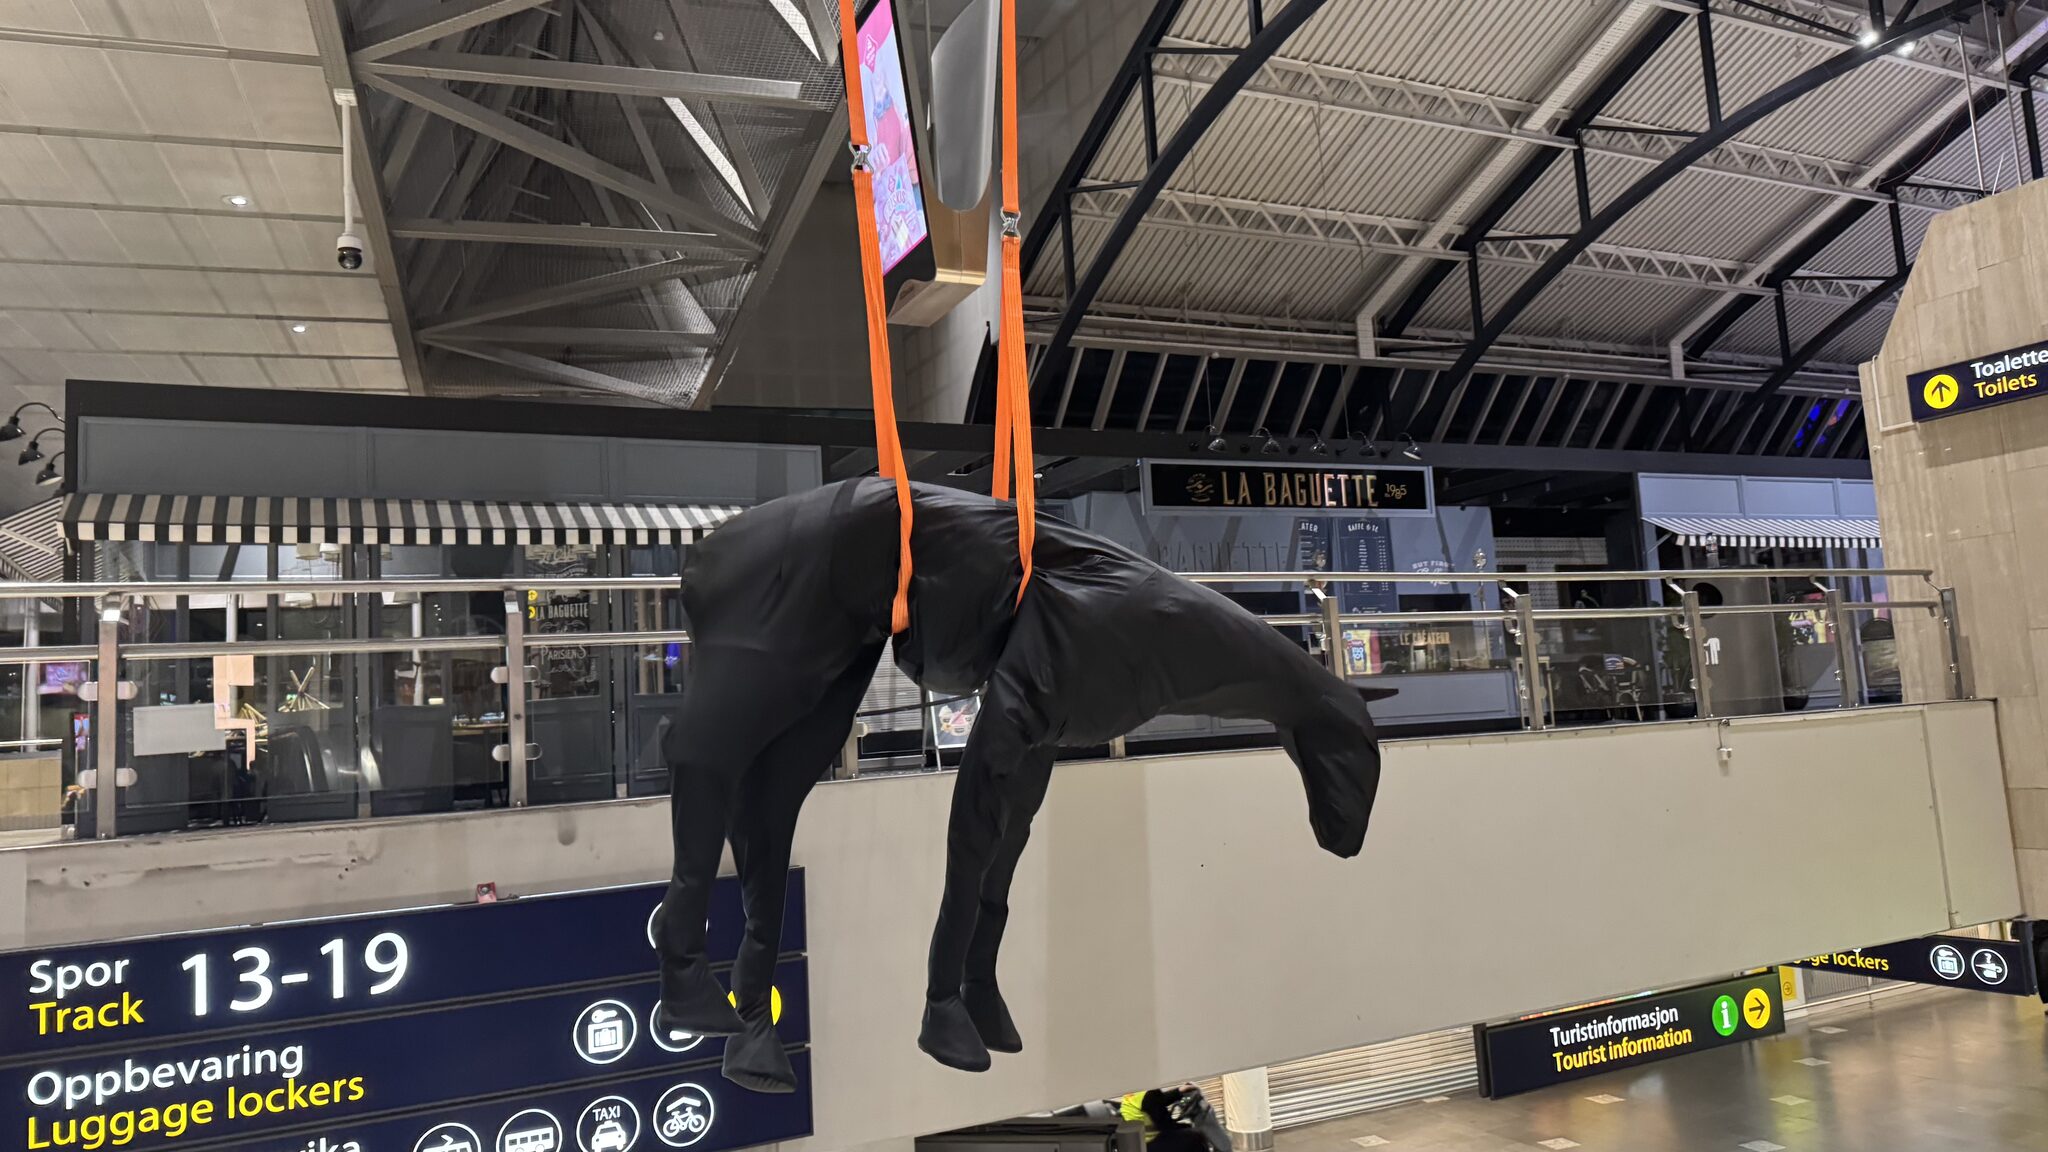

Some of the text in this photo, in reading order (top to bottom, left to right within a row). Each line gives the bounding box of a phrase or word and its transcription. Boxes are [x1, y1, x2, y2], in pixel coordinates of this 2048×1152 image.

[1973, 373, 2038, 399] Toilets
[1221, 471, 1379, 507] LA BAGUETTE
[548, 603, 589, 619] BAGUETTE
[29, 957, 130, 998] Spor
[182, 932, 409, 1016] 13-19
[1832, 950, 1890, 972] lockers
[29, 991, 144, 1035] Track
[1550, 1005, 1678, 1048] Turistinformasjon
[1553, 1027, 1692, 1073] Tourist information
[27, 1045, 305, 1109] Oppbevaring
[27, 1075, 365, 1149] Luggage lockers
[592, 1105, 621, 1121] TAXI
